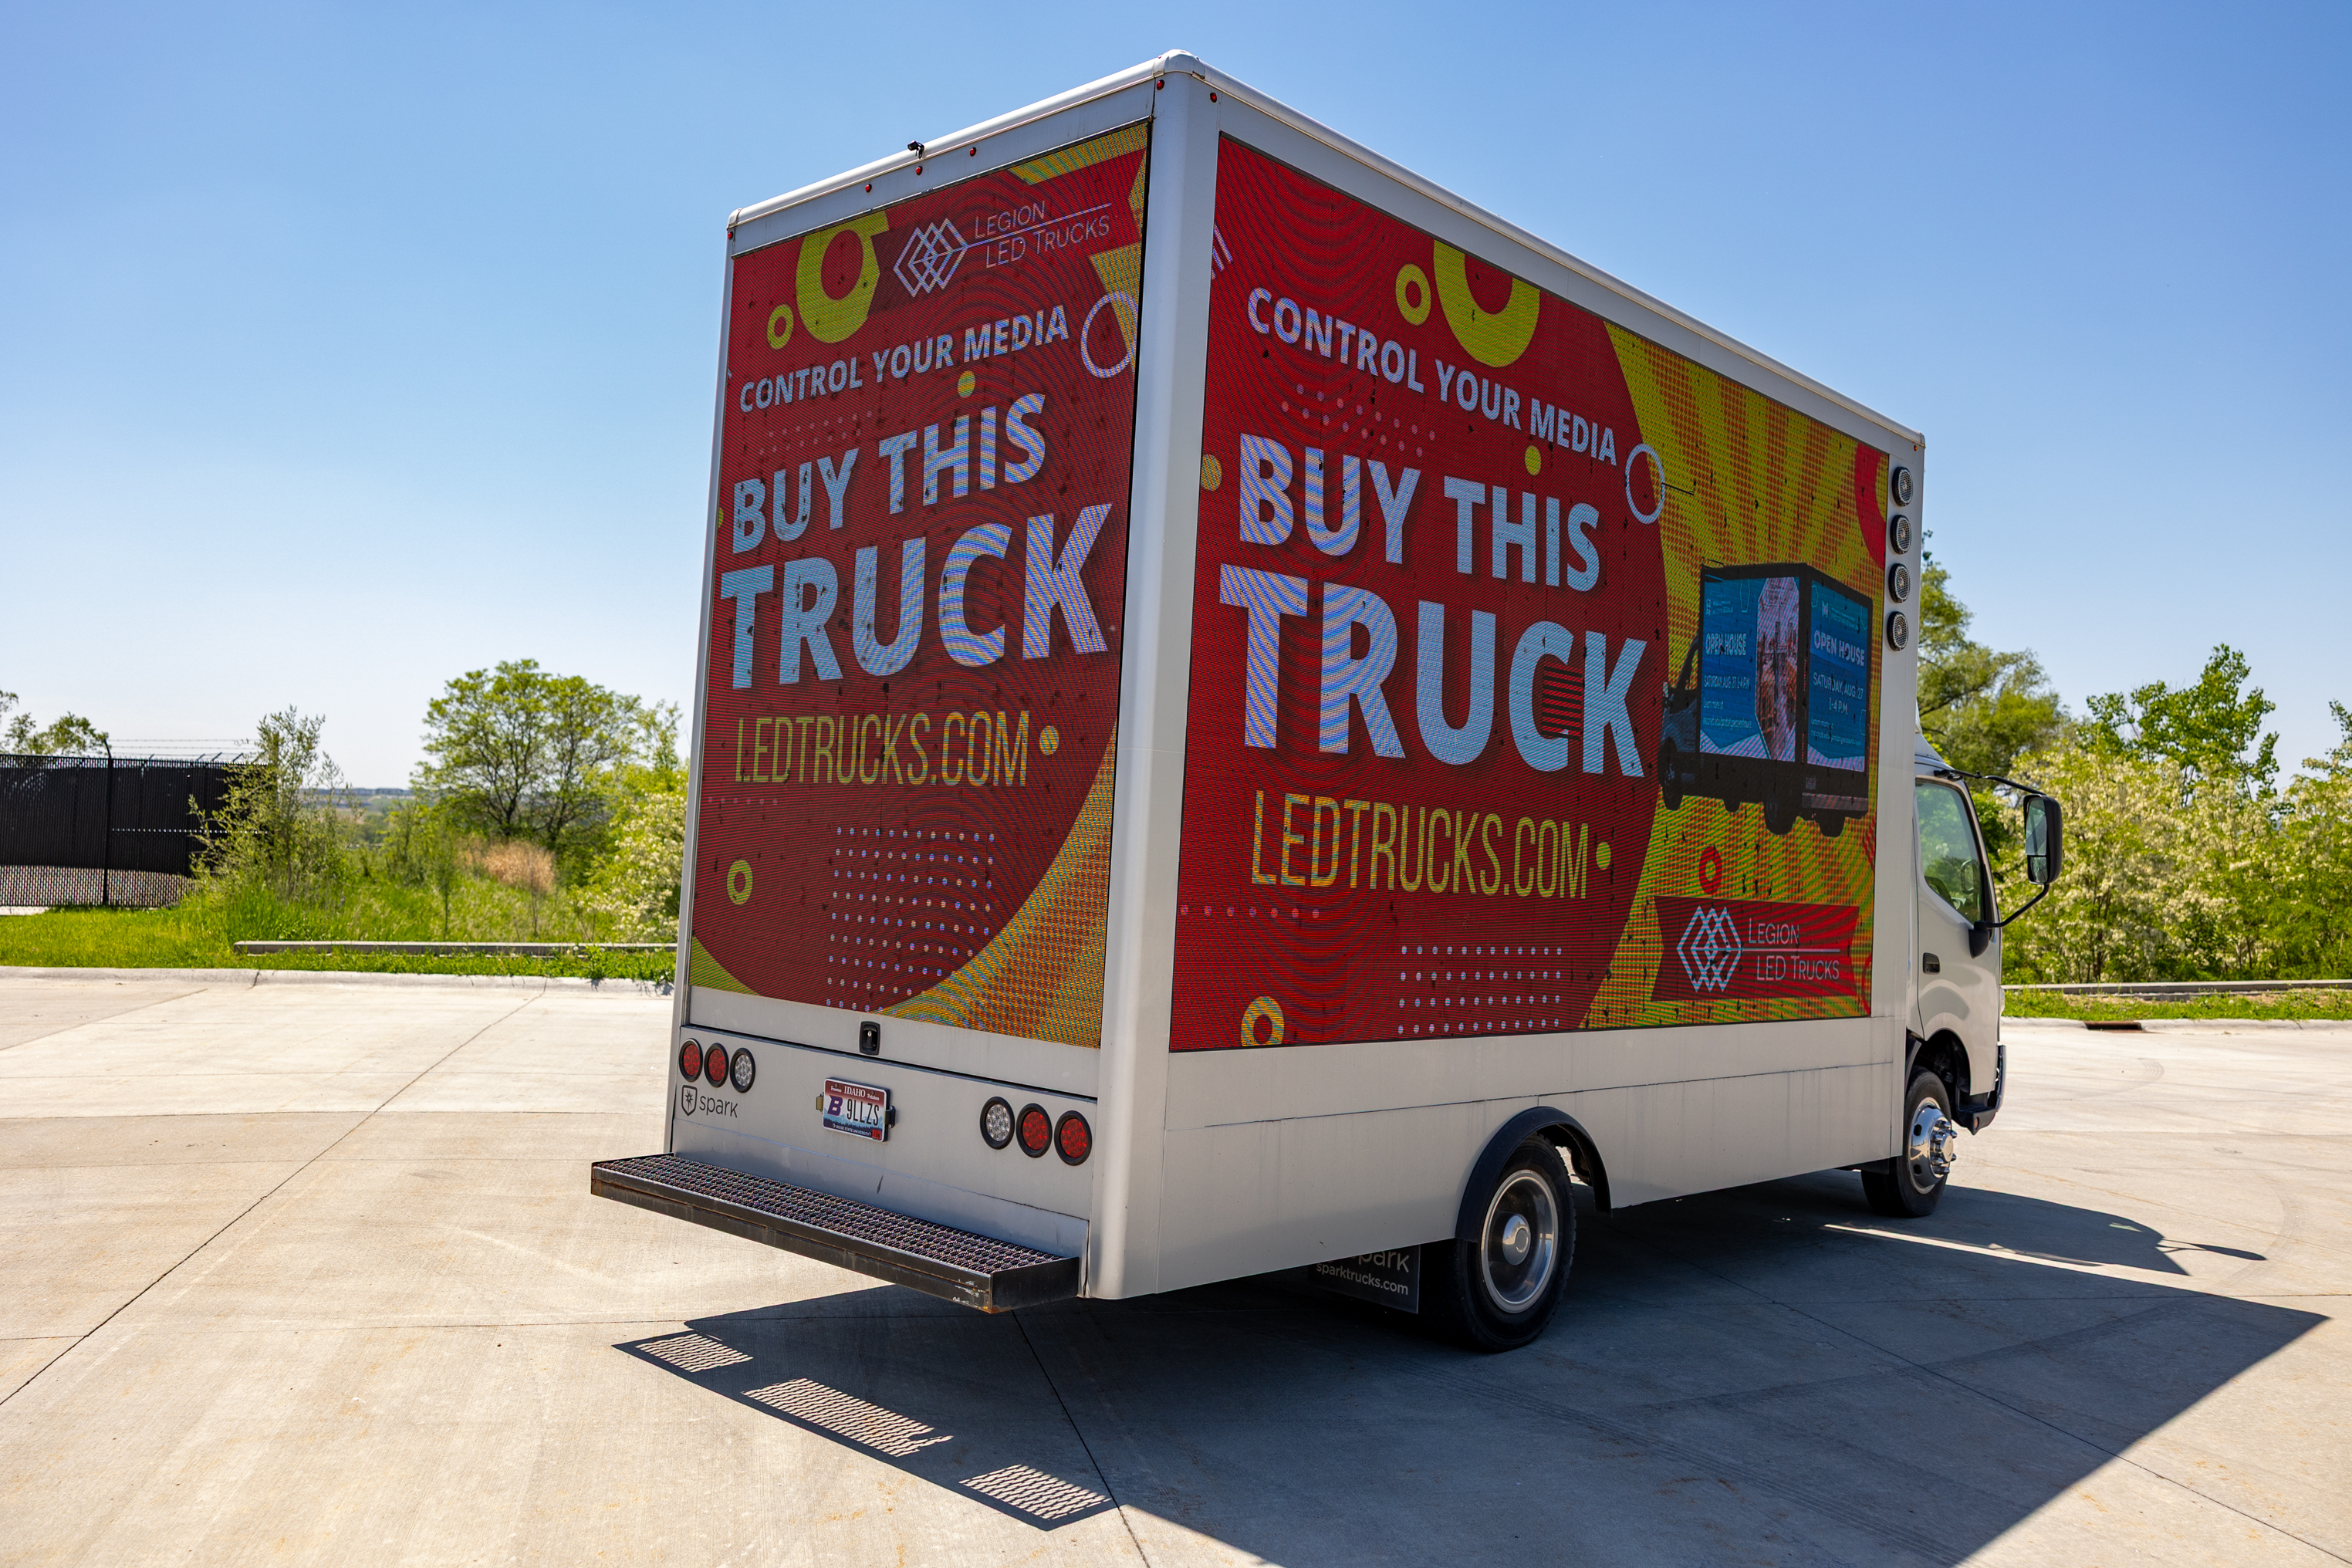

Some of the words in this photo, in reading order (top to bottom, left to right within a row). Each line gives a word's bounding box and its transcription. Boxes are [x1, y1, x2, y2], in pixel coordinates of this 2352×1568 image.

[986, 236, 1026, 269] LED
[739, 357, 863, 413] CONTROL
[871, 333, 954, 383] YOUR
[963, 305, 1070, 360] MEDIA
[1248, 287, 1424, 394] CONTROL
[1435, 359, 1522, 430] YOUR
[1531, 398, 1617, 466] MEDIA
[732, 448, 859, 555] BUY
[879, 392, 1046, 515] THIS
[1239, 433, 1421, 565] BUY
[1444, 475, 1600, 593] THIS
[721, 502, 1113, 689] TRUCK
[1705, 633, 1723, 655] OPEN
[1725, 633, 1747, 655] HOUSE
[1813, 629, 1837, 656] OPEN
[1838, 640, 1865, 667] HOUSE
[1219, 563, 1647, 779] TRUCK
[735, 710, 1030, 787] LEDTRUCKS.COM
[1252, 789, 1589, 899] LEDTRUCKS.COM
[1756, 955, 1786, 981] LED
[699, 1096, 738, 1118] spark
[844, 1086, 866, 1097] IDAHO
[847, 1099, 879, 1126] 9LLZS
[1316, 1262, 1408, 1296] sparktrucks.com
[1351, 1250, 1410, 1273] park
